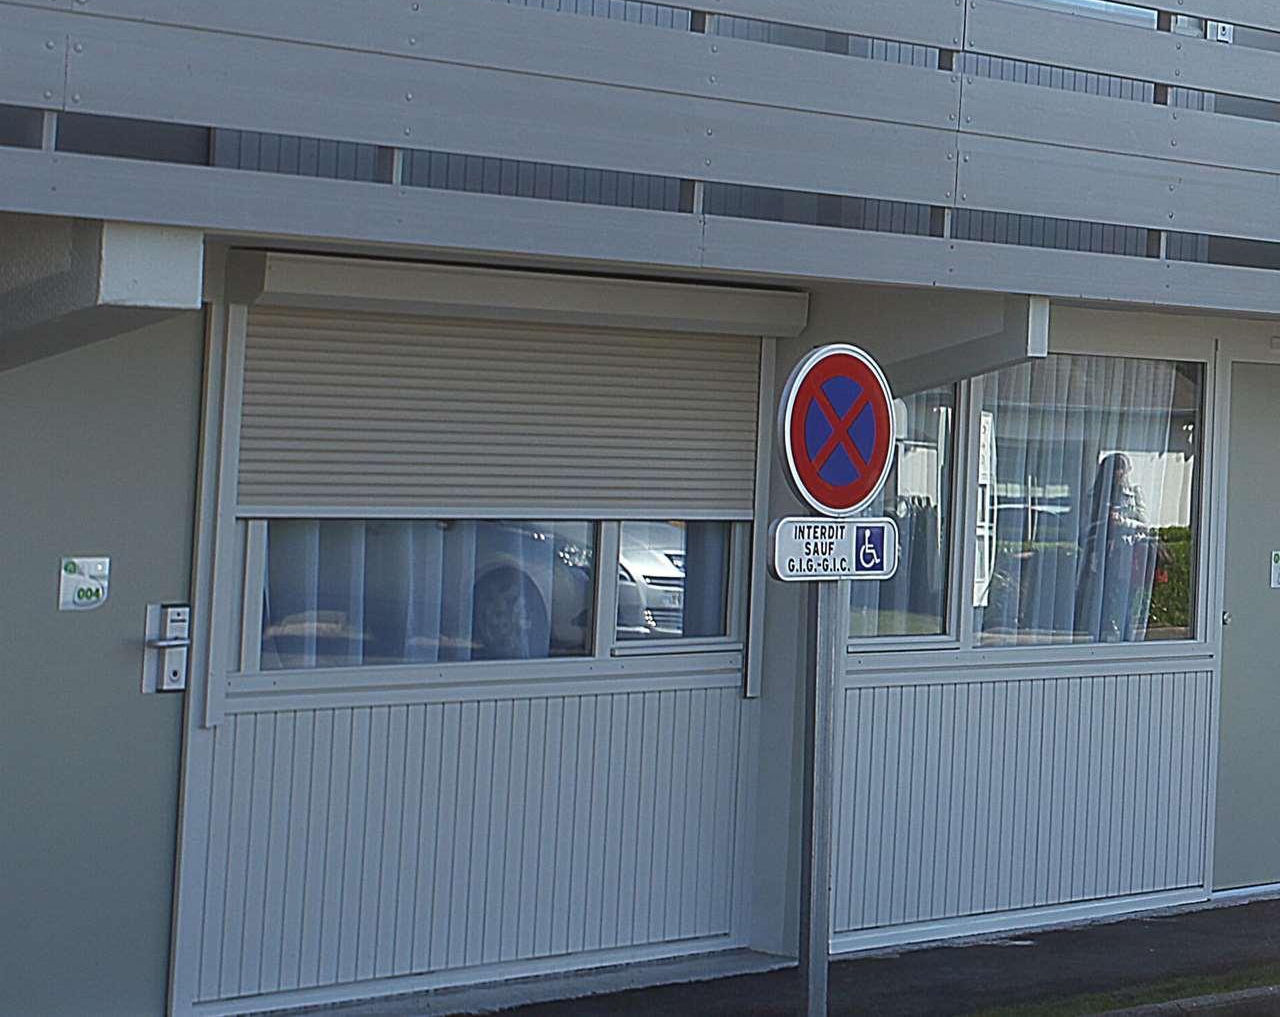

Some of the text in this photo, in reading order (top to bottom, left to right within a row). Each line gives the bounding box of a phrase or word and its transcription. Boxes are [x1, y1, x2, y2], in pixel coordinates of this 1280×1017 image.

[794, 525, 846, 540] INTERDIT
[804, 542, 835, 556] SAUF
[77, 587, 101, 600] 004
